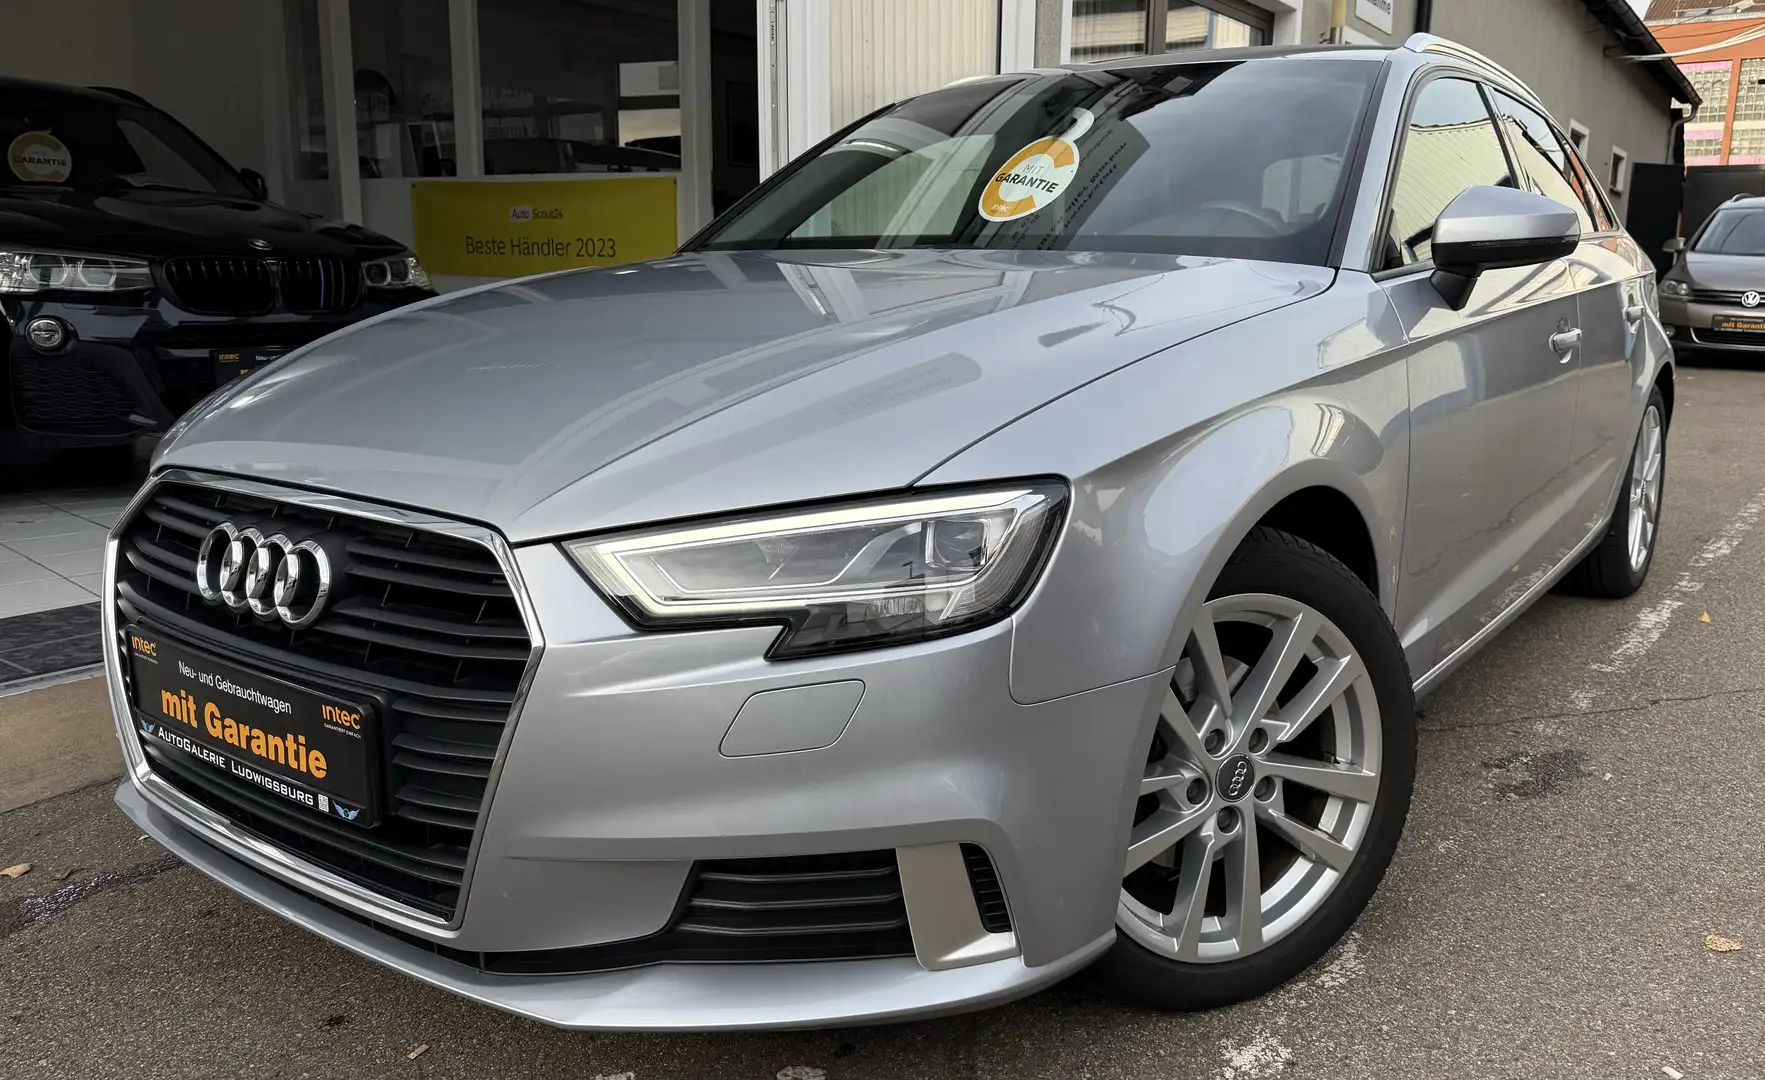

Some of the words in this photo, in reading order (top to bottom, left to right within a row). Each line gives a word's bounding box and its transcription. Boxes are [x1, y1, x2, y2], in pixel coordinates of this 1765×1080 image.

[1022, 163, 1045, 175] MIT
[995, 172, 1060, 193] GARANTIE
[511, 208, 530, 220] Auto
[532, 208, 564, 220] Scout24
[465, 236, 506, 255] Beste
[510, 236, 572, 258] Händler
[576, 237, 617, 258] 2023
[1736, 322, 1765, 330] Garanti
[178, 660, 197, 679] Neu-
[198, 671, 214, 687] und
[215, 675, 292, 715] Gebrauchtwagen
[161, 689, 198, 729] mit
[204, 701, 328, 779] Garantie
